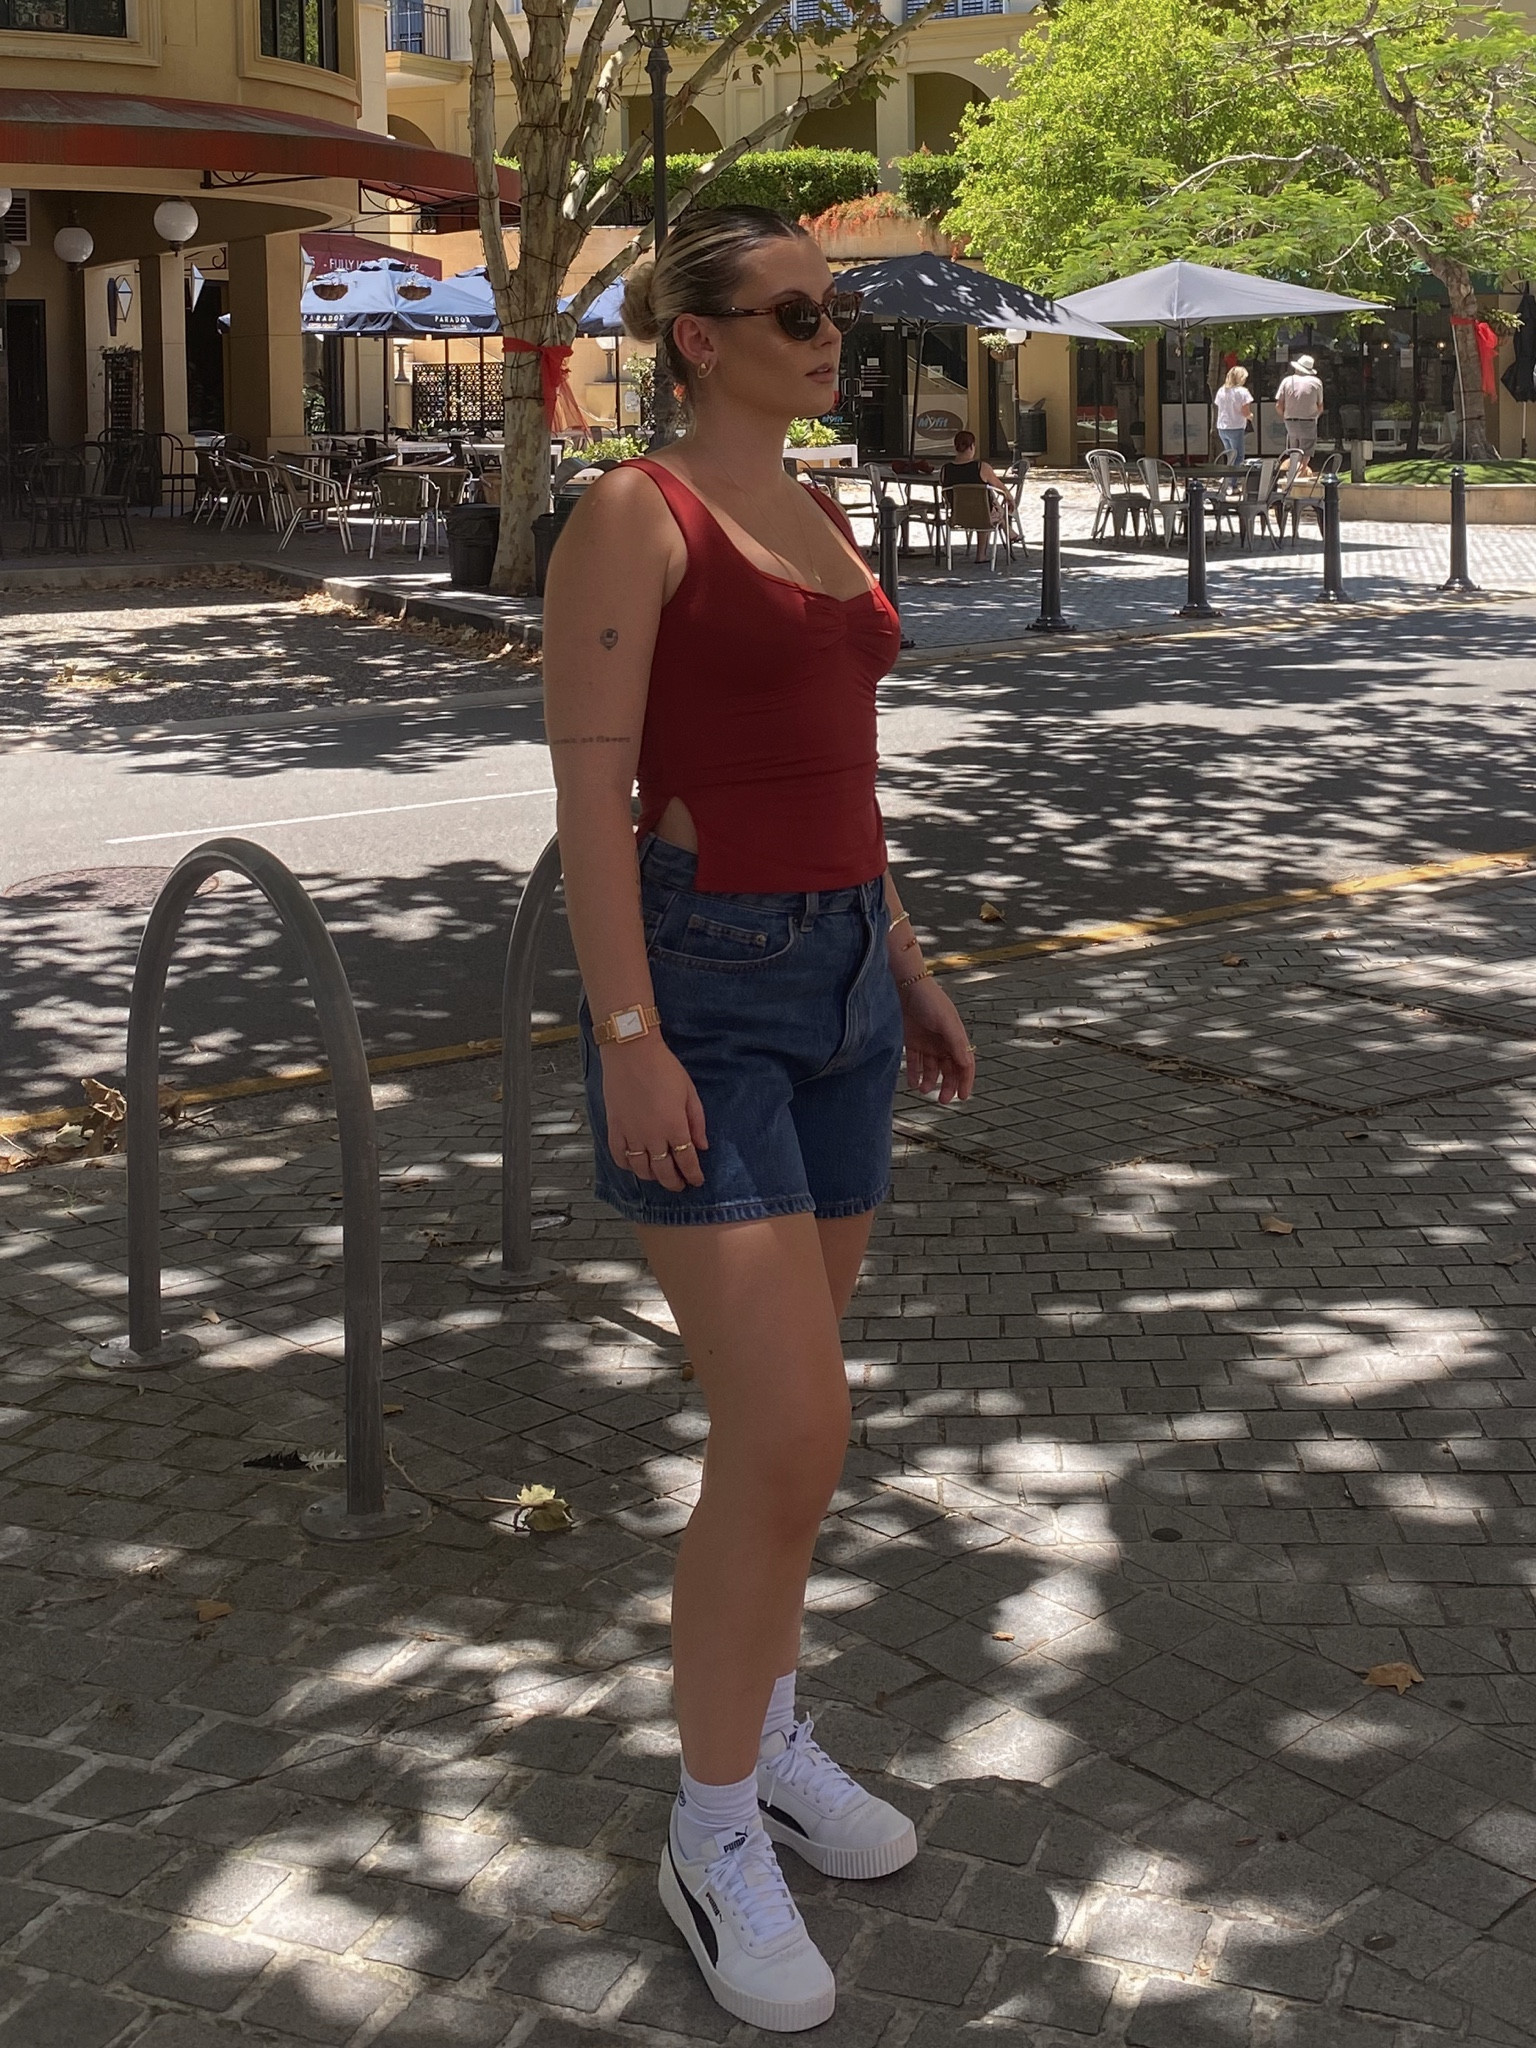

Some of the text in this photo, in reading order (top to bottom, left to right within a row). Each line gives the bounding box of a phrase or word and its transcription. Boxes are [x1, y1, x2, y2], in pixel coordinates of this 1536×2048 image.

[329, 258, 355, 270] FULLY
[434, 315, 470, 323] PARADOX
[723, 1836, 746, 1853] PUMA
[705, 1891, 720, 1917] PUMA
